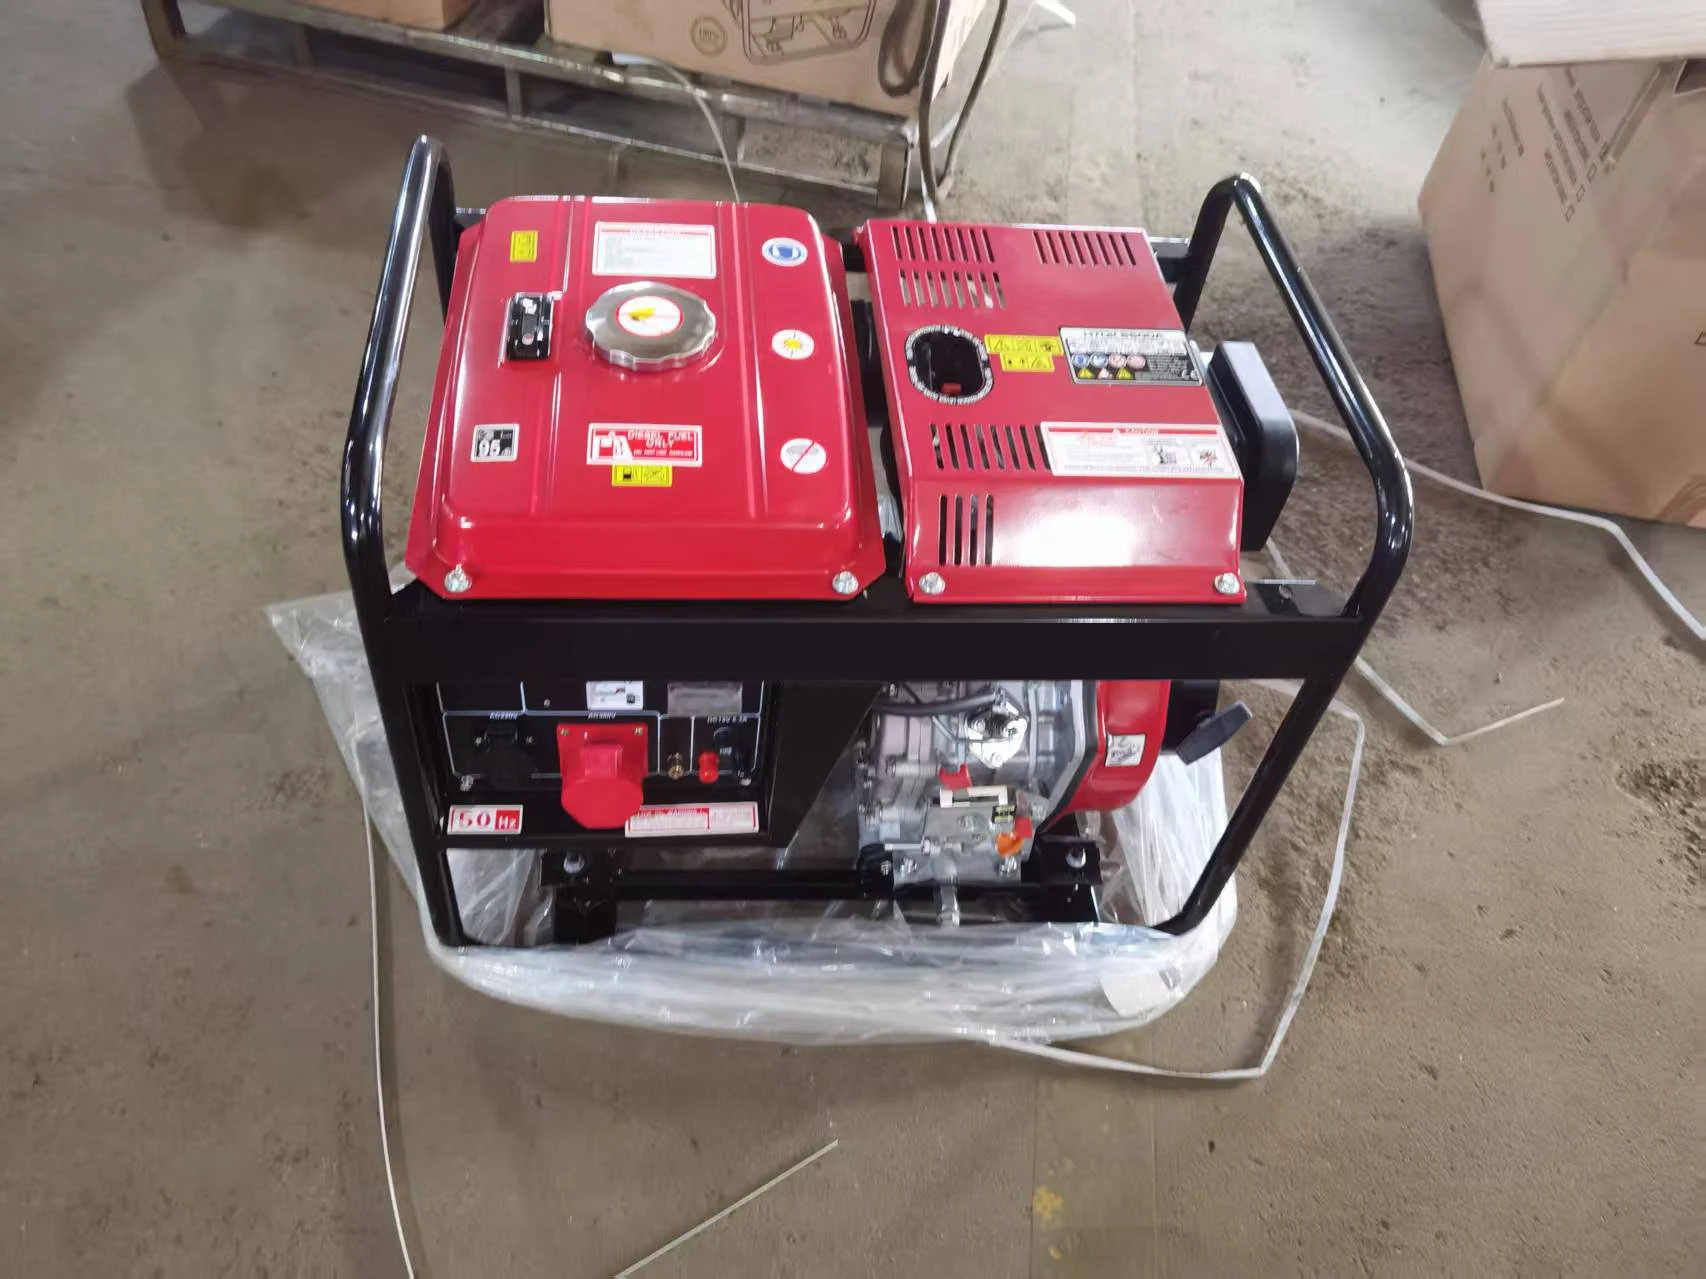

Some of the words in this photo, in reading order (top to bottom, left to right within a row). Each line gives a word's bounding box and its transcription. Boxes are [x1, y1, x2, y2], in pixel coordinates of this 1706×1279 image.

[627, 430, 662, 441] DIESEL
[667, 431, 694, 442] FUEL
[646, 439, 675, 449] ONLY
[459, 809, 491, 831] 50
[498, 815, 517, 831] Hz
